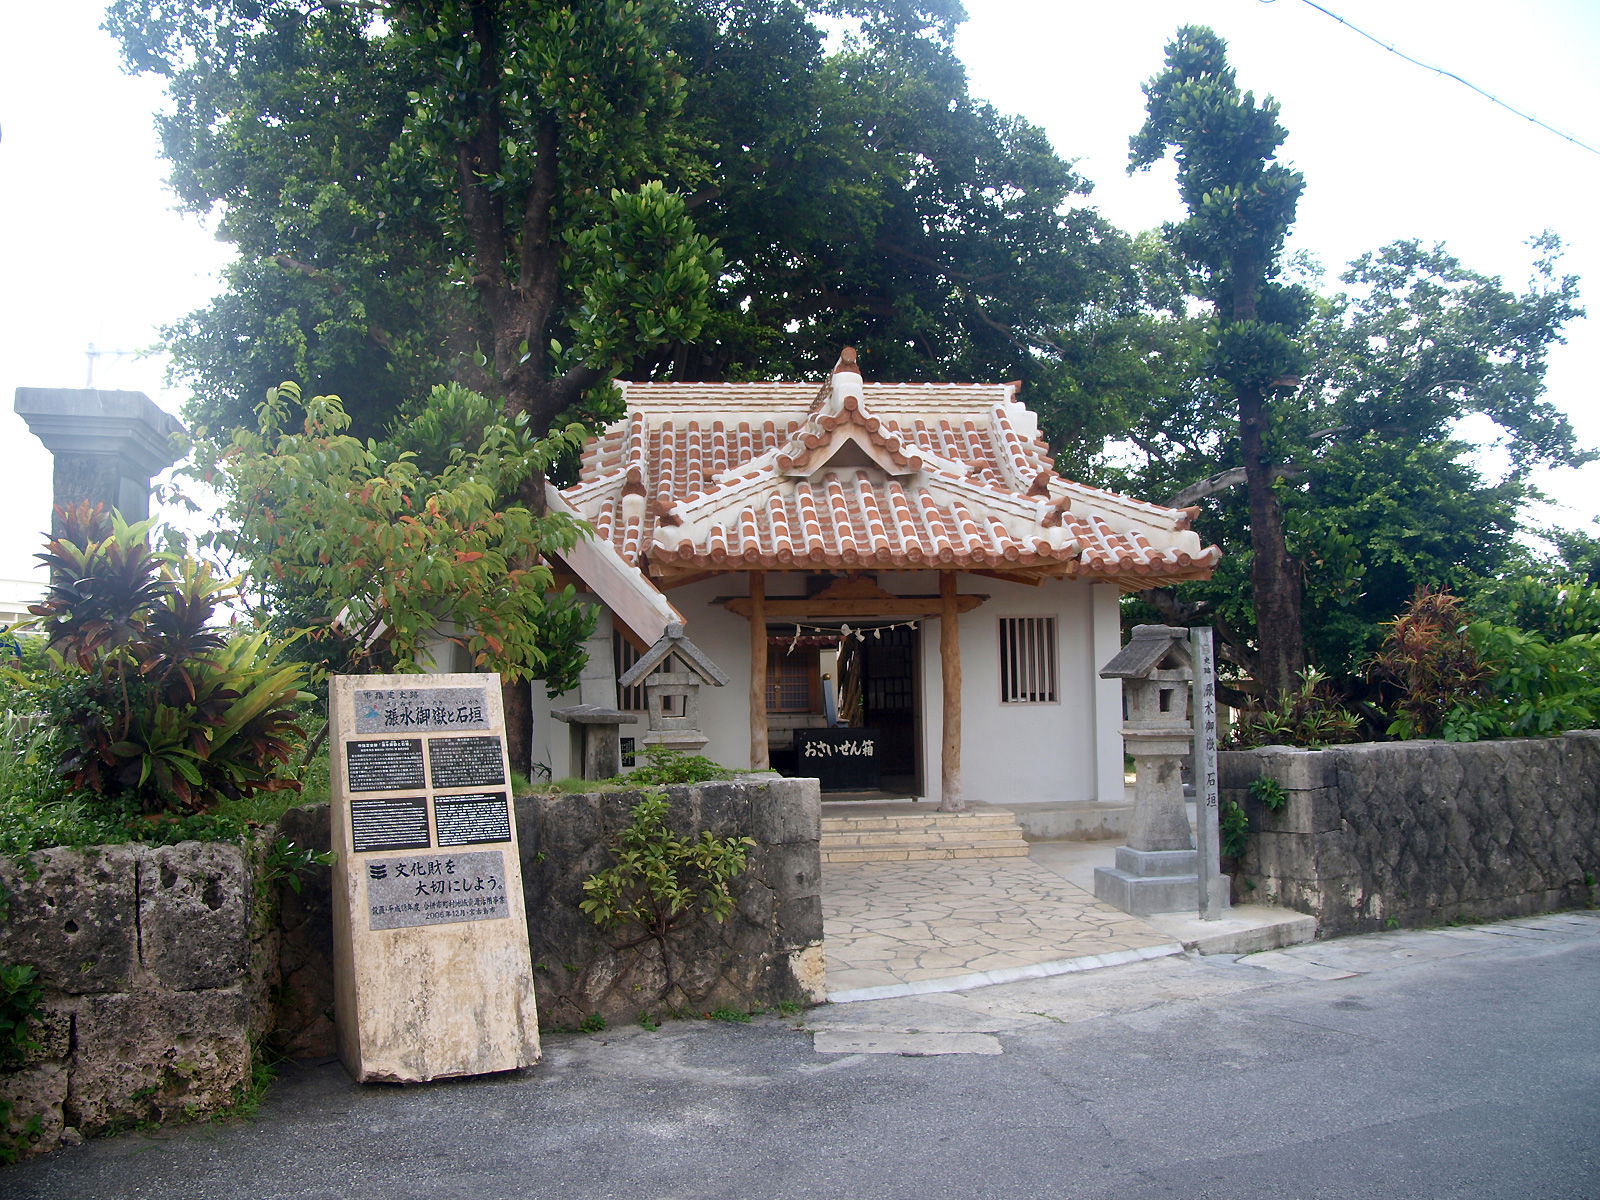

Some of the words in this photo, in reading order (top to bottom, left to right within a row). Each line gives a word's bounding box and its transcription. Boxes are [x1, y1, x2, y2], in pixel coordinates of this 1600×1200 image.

[804, 739, 875, 758] おさいせん箱
[395, 858, 456, 879] 文化財を
[415, 875, 503, 897] 大切にしよう。
